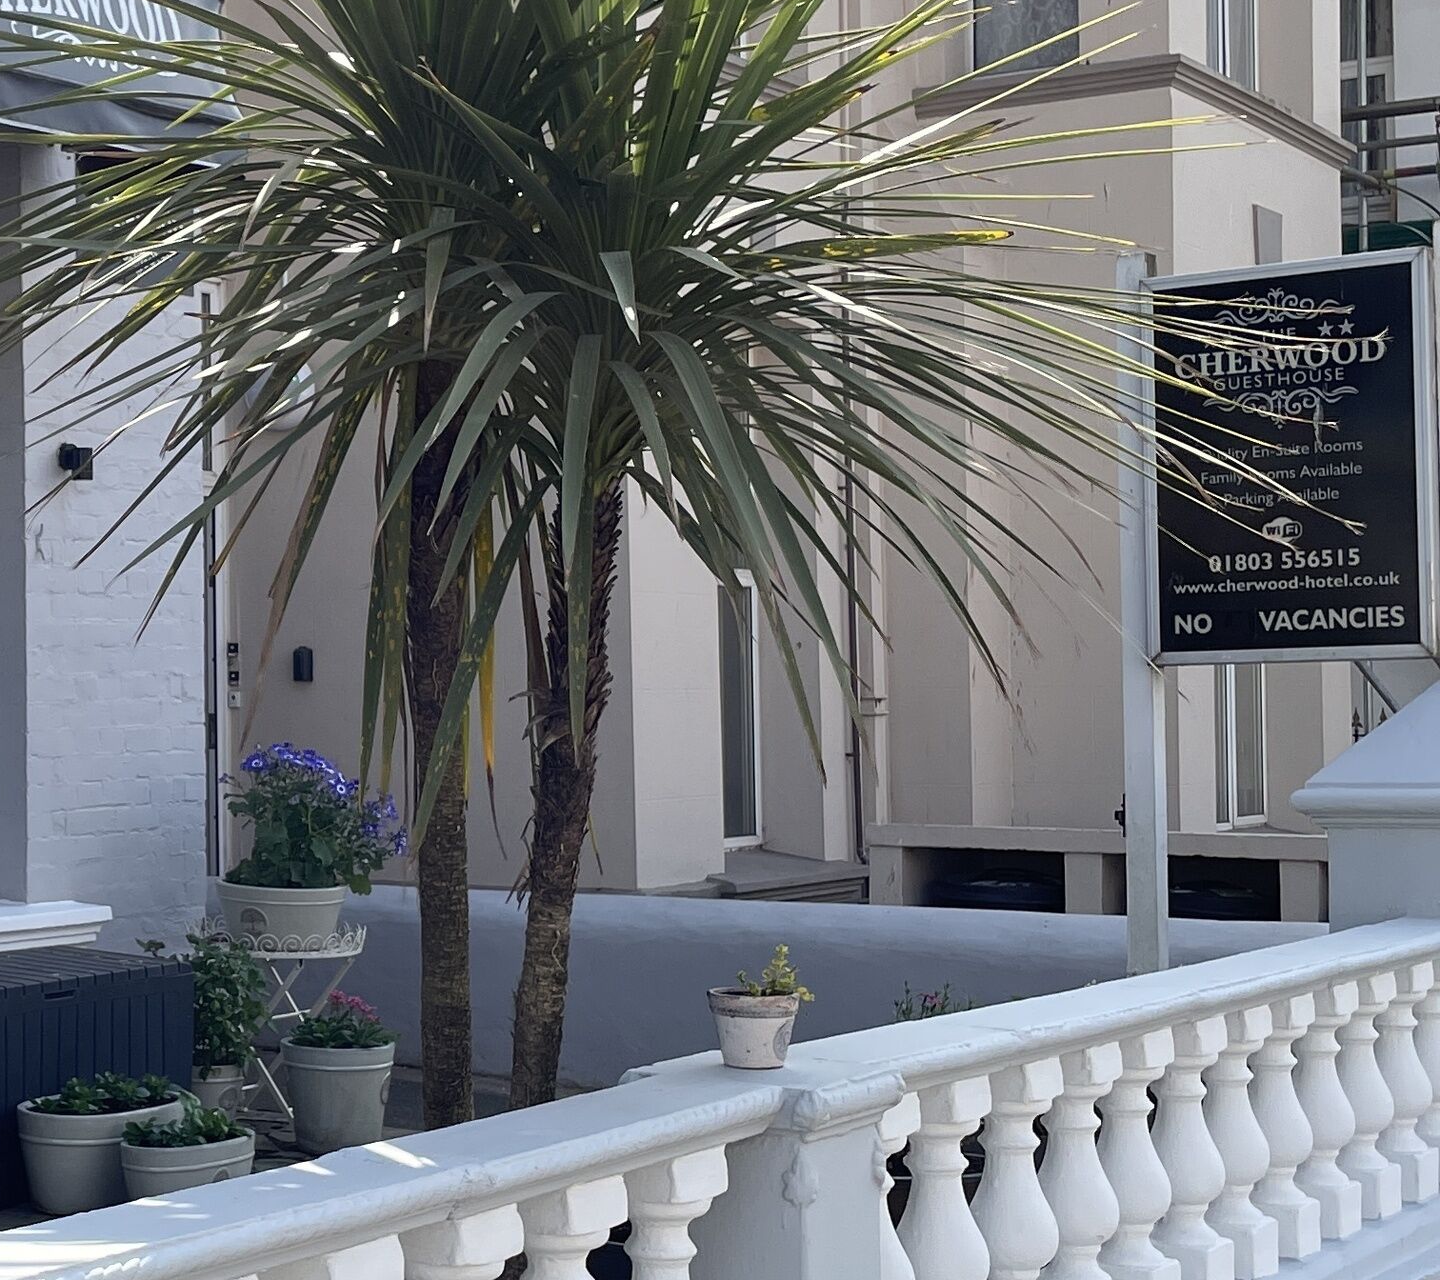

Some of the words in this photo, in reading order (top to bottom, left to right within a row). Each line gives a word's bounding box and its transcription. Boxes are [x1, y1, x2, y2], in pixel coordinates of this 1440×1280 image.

[1174, 338, 1387, 380] CHERWOOD
[1213, 367, 1345, 392] GUESTHOUSE
[1252, 443, 1310, 459] En-Suite
[1314, 440, 1364, 455] Rooms
[1201, 470, 1245, 486] Family
[1247, 467, 1296, 481] oms
[1299, 461, 1364, 478] Available
[1224, 492, 1274, 508] Parking
[1277, 487, 1340, 504] Aailable
[1210, 551, 1273, 573] 01803
[1281, 547, 1361, 569] 556515
[1173, 571, 1401, 595] www.cherwood-hotel.co.uk
[1174, 613, 1213, 635] NO
[1258, 605, 1406, 632] VACANCIES
